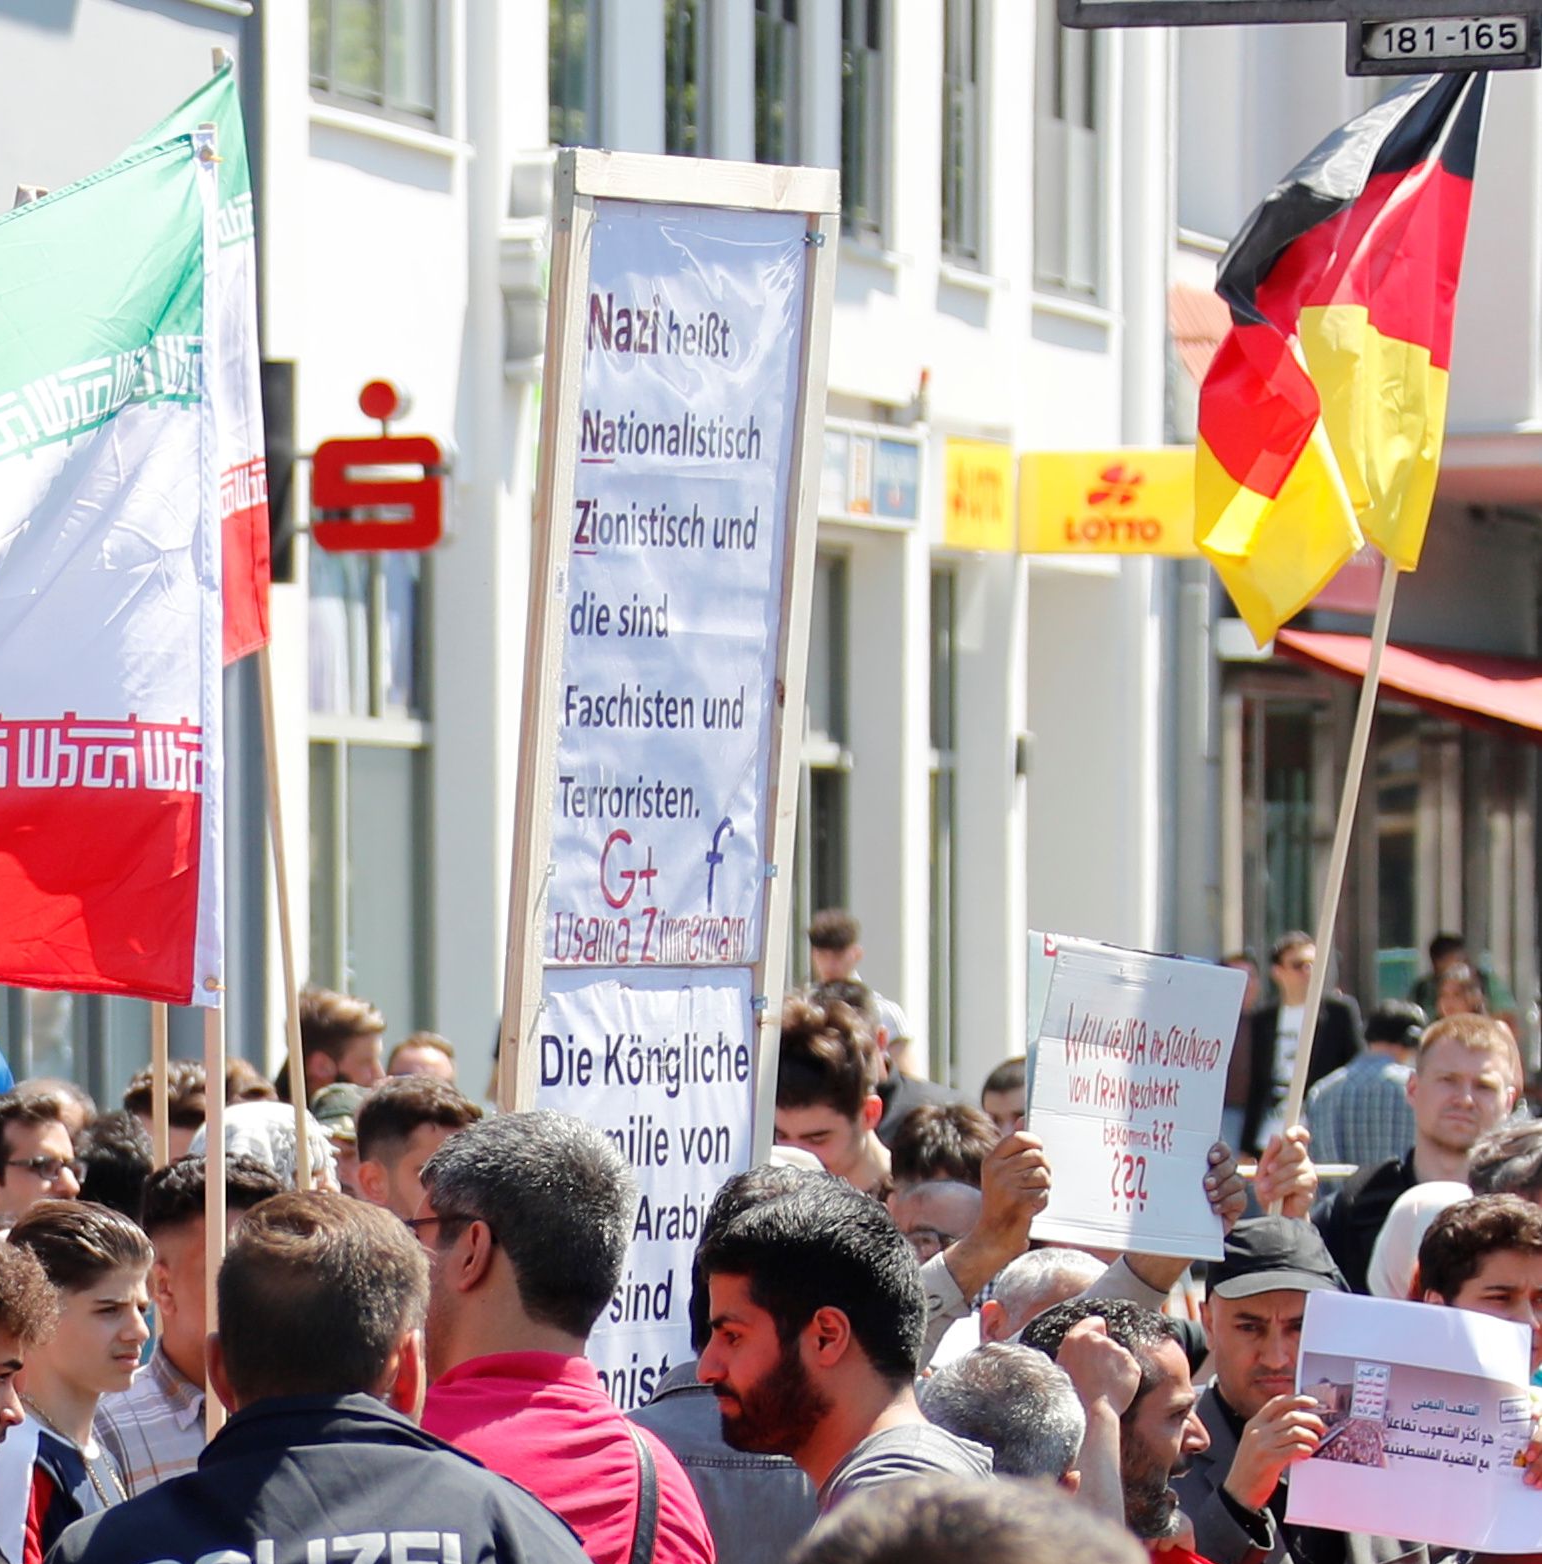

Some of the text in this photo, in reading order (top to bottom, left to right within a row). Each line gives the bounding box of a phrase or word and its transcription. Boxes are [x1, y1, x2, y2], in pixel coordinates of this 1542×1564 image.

[588, 293, 730, 358] Nazi heißt
[581, 409, 761, 460] Nationalistisch
[574, 499, 759, 550] Zionistisch und
[1064, 516, 1161, 544] LOTTO
[570, 590, 669, 638] die sind
[565, 683, 745, 730] Faschisten und
[559, 775, 701, 819] Terroristen.
[554, 906, 746, 964] Usama Zimmermann
[541, 1035, 593, 1087] Die
[680, 1126, 730, 1165] von
[610, 1269, 673, 1323] sind
